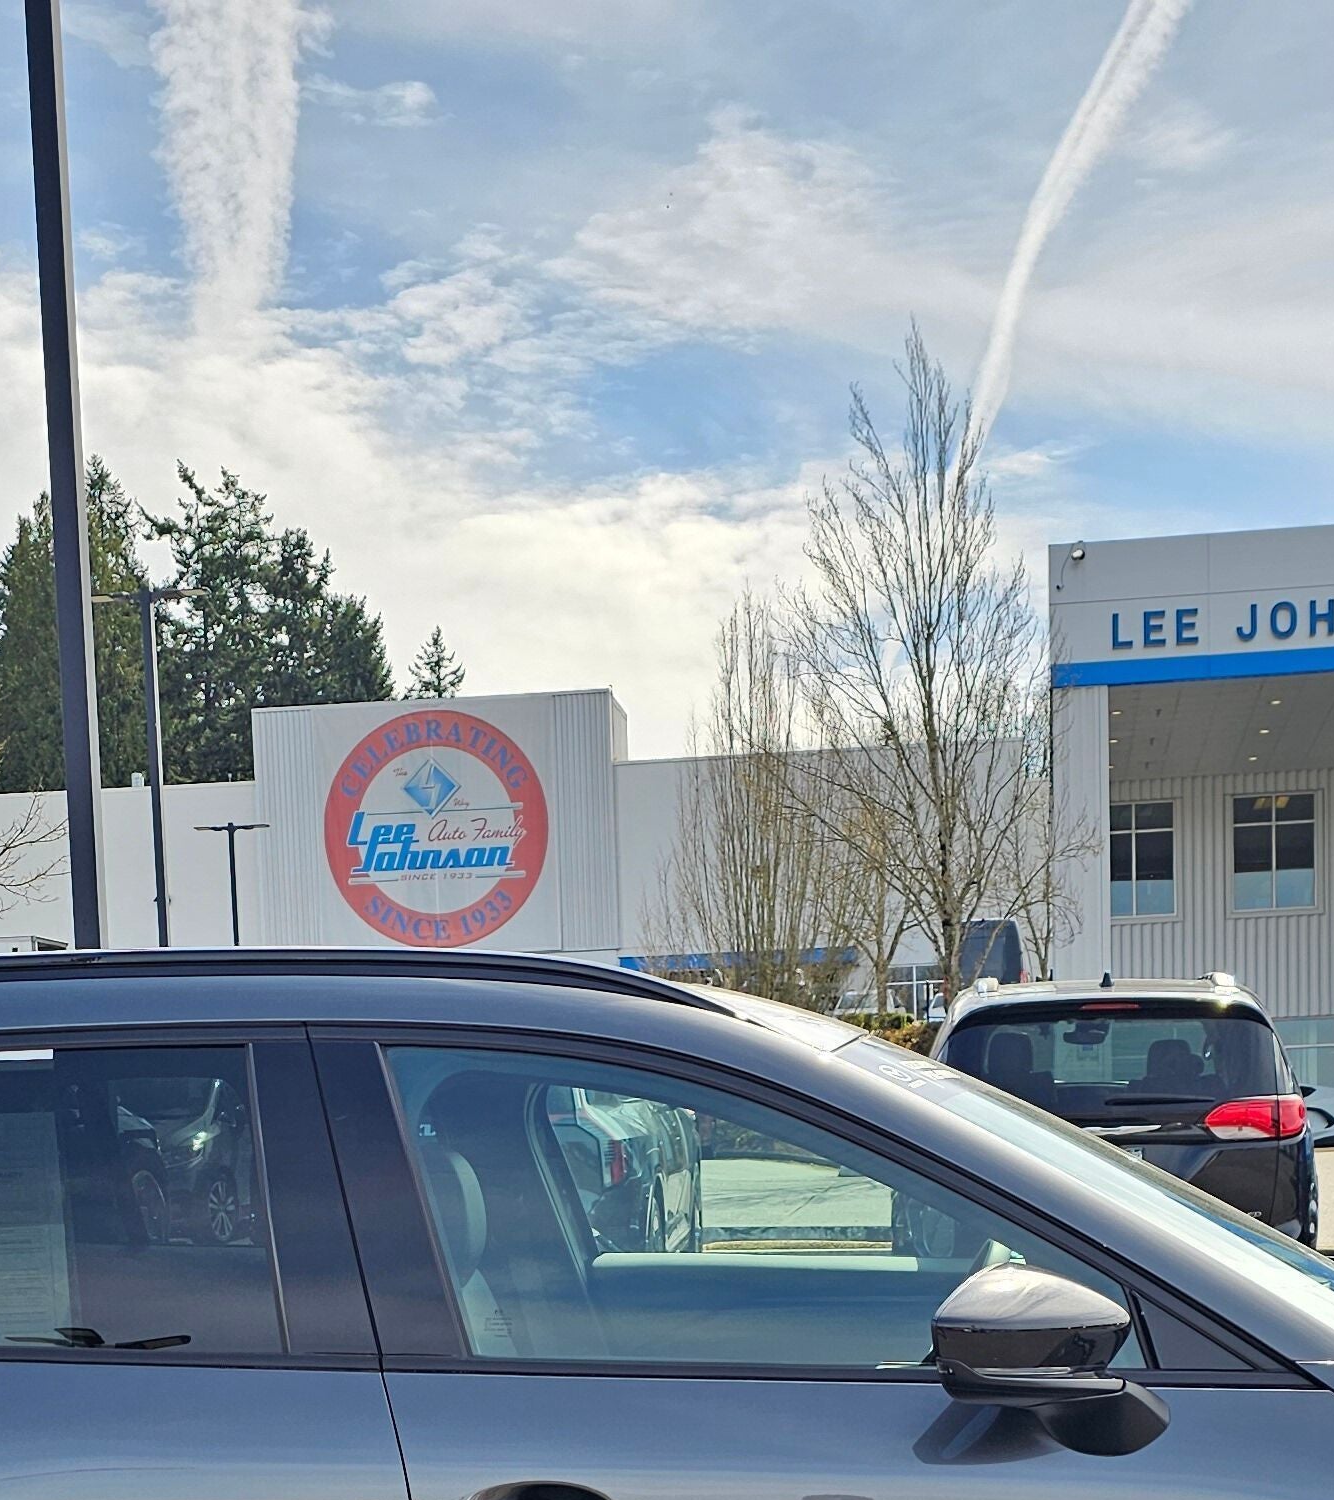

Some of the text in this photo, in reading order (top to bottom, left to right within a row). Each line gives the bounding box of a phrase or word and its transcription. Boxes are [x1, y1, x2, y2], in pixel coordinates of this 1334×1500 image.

[1111, 607, 1200, 651] LEE
[340, 719, 528, 798] CELEBRATING
[348, 811, 526, 848] Lee Auto Family
[352, 838, 515, 873] Johnson
[400, 872, 474, 881] SINCE 1933
[364, 889, 514, 941] SINCE 1933
